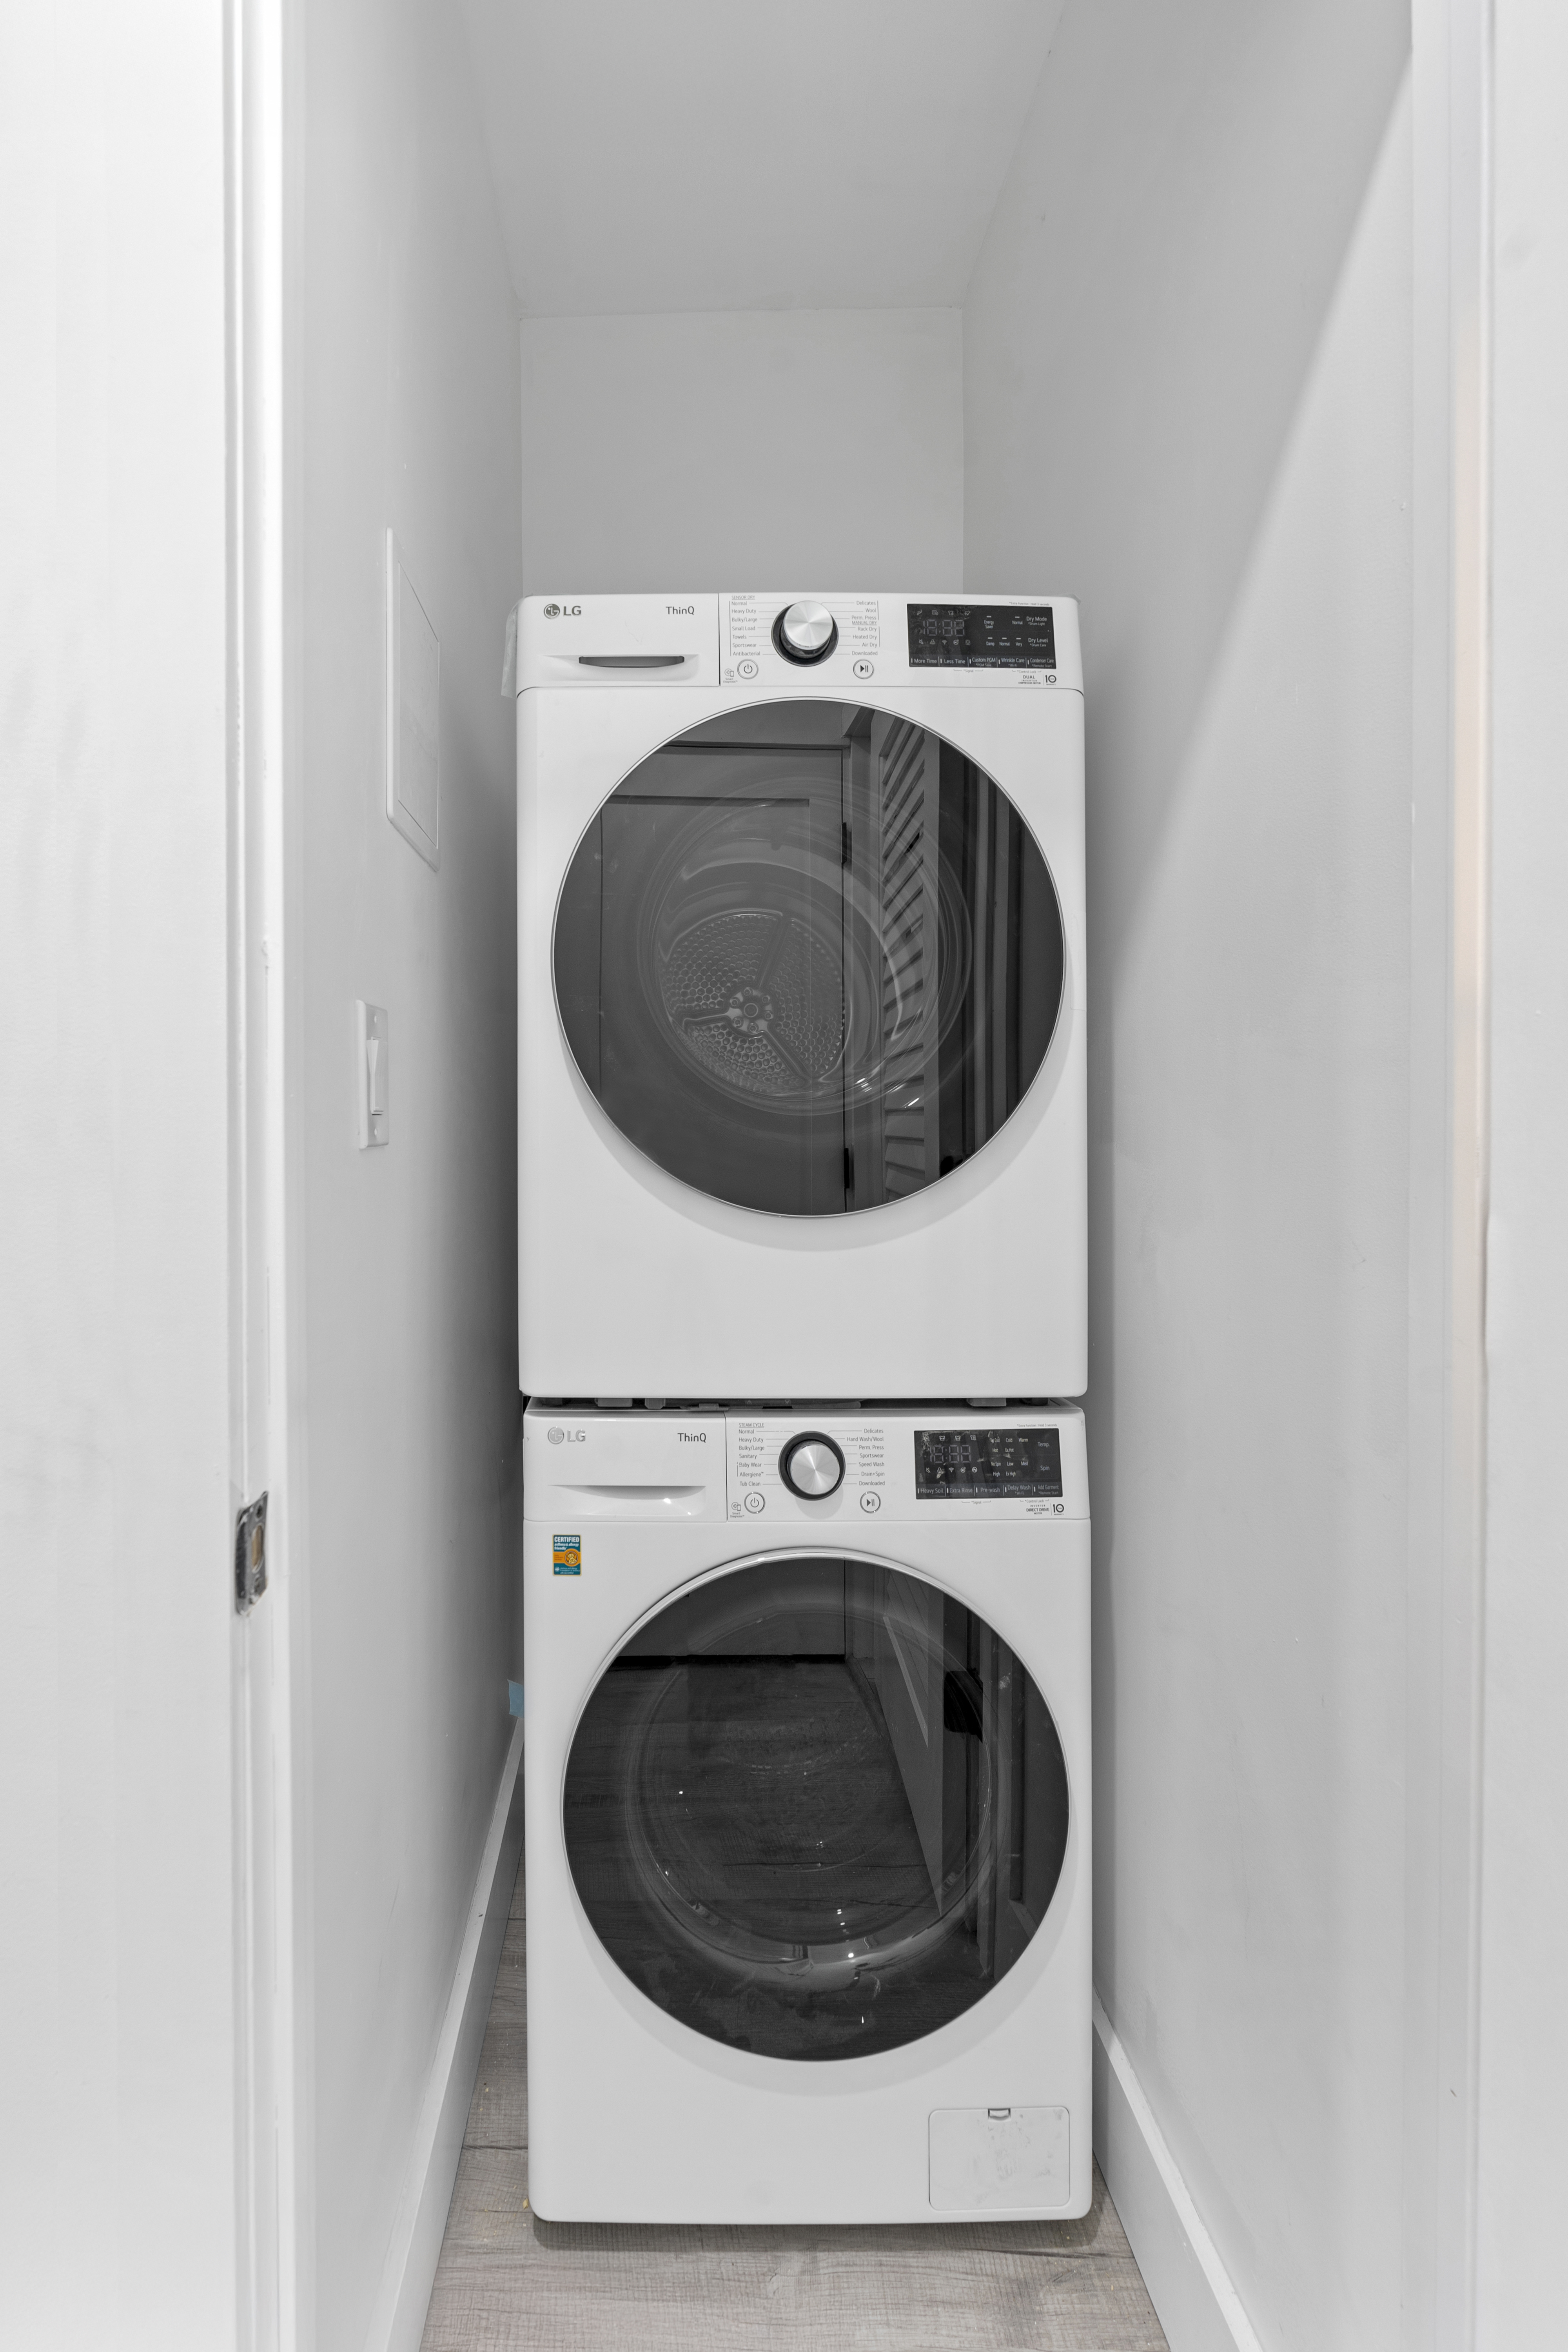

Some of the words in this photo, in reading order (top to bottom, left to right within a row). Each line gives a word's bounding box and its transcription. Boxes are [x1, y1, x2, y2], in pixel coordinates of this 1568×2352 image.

[563, 606, 581, 616] LG
[666, 606, 695, 615] ThinQ
[1045, 675, 1056, 683] 10
[567, 1429, 586, 1442] LG
[677, 1433, 706, 1443] ThinQ
[1053, 1504, 1064, 1513] 10
